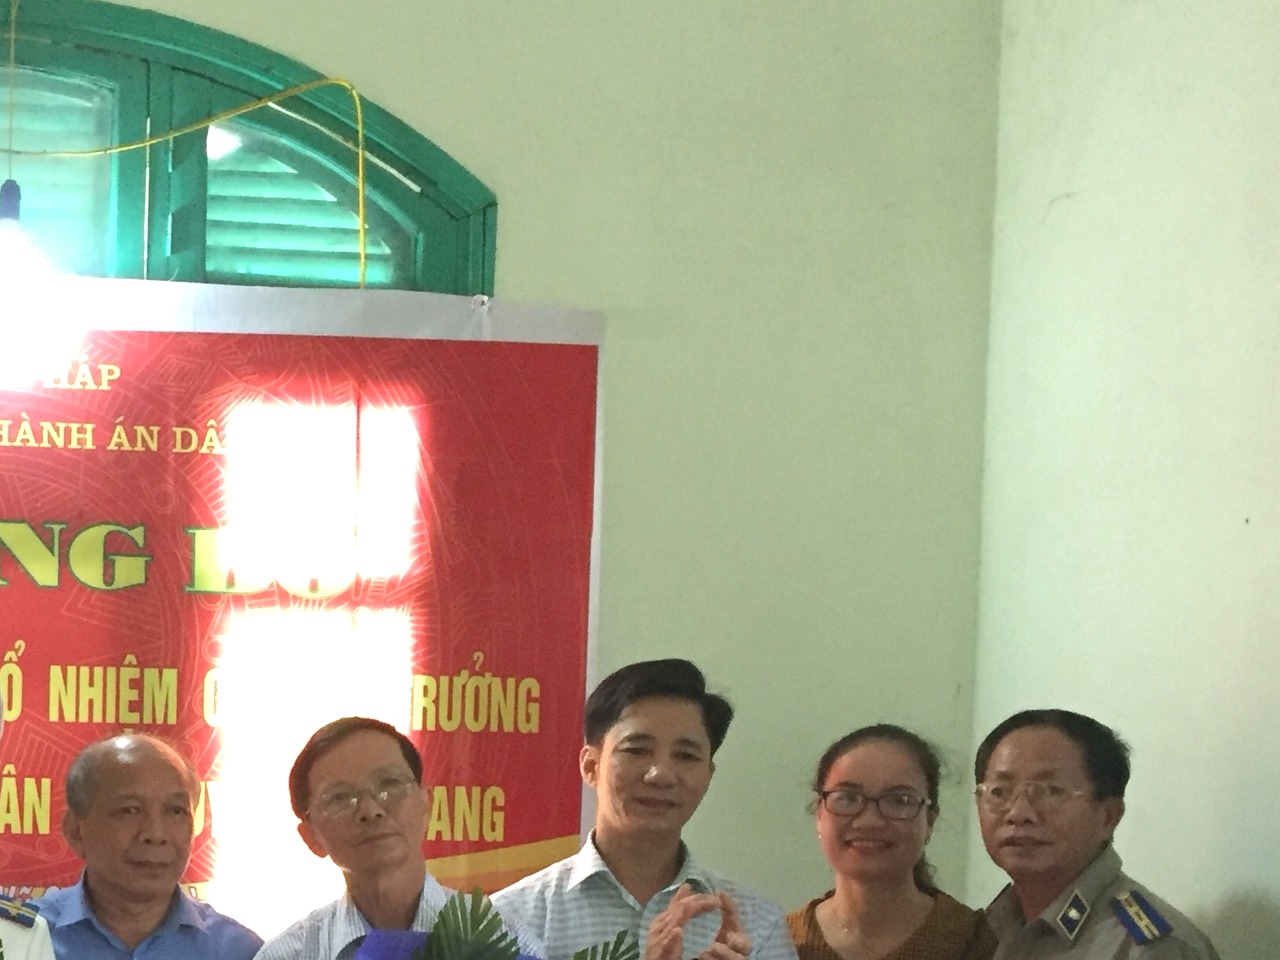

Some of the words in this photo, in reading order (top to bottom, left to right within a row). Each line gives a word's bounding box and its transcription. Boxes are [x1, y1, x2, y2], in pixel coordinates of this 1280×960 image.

[106, 416, 160, 452] ÁN
[171, 418, 226, 455] DÂ
[48, 653, 179, 734] NHIỆM
[411, 650, 541, 734] RƯỞNG
[426, 785, 506, 842] ANG
